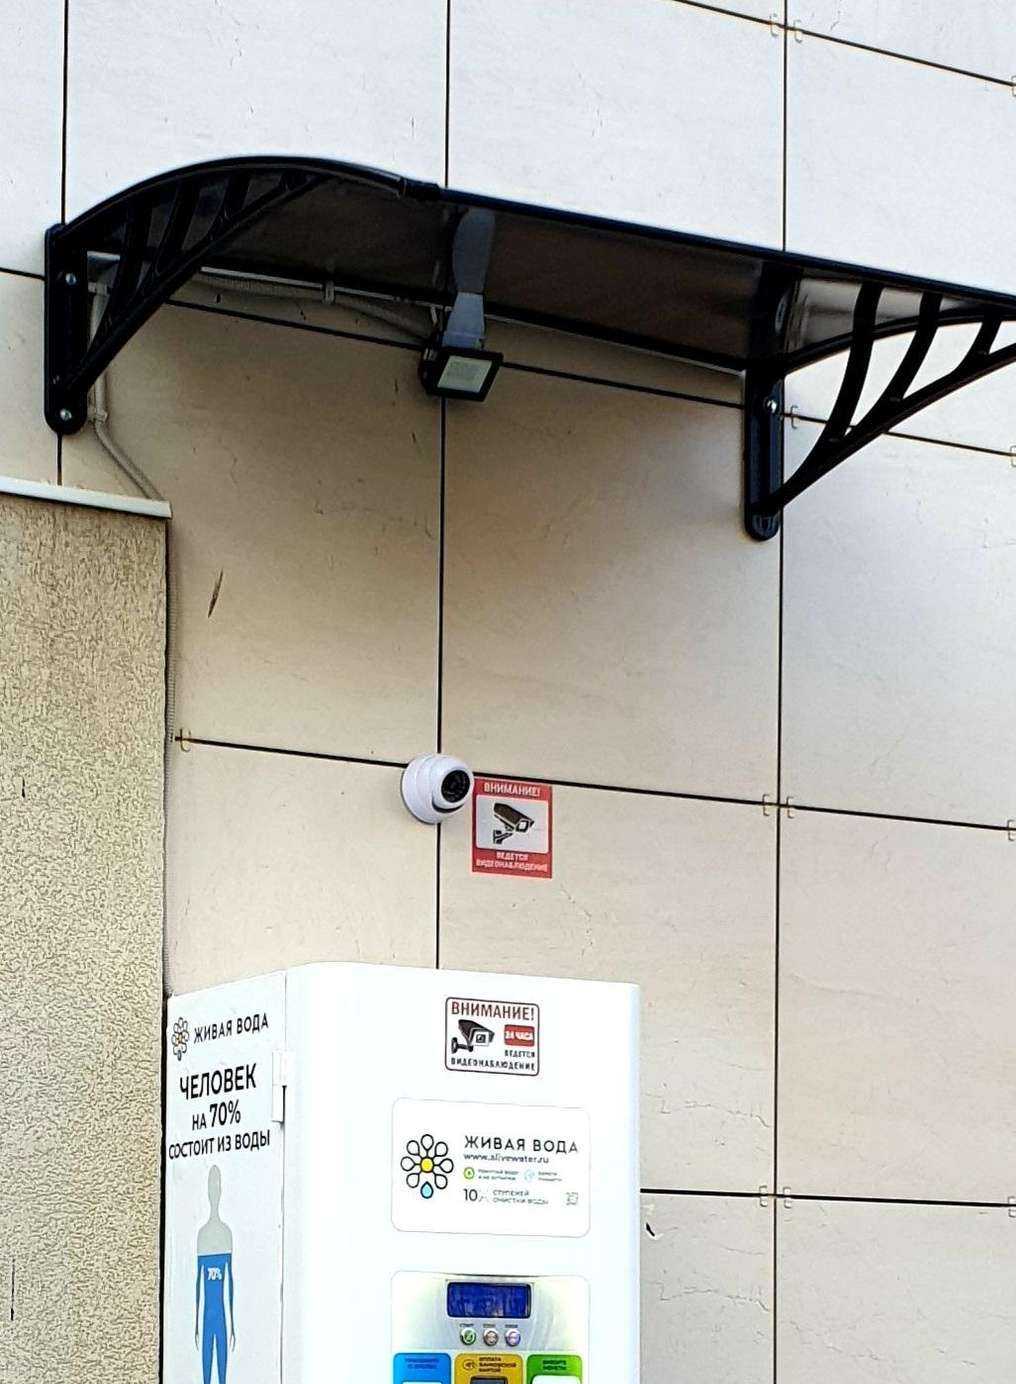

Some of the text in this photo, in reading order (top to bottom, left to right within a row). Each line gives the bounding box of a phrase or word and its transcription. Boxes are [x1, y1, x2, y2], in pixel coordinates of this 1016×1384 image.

[484, 782, 540, 797] ВНИМАНИЕ!
[496, 851, 529, 861] ВЕДЕТСЯ
[451, 1001, 535, 1021] ВНИМАНИЕ!
[194, 1012, 269, 1044] ЖИВАЯ ВОДА
[504, 1050, 535, 1058] ВЕДЕТСЯ
[451, 1057, 536, 1071] ВИДЕОНАБЛЮДЕНИЕ
[180, 1063, 257, 1100] ЧЕЛОВЕК
[192, 1099, 241, 1131] НА 70%
[168, 1129, 270, 1160] СОСТОИТ ИЗ ВОДЫ
[464, 1135, 579, 1155] ЖИВАЯ ВОДА
[463, 1153, 550, 1164] www.alivewater.ru
[463, 1188, 478, 1202] 10
